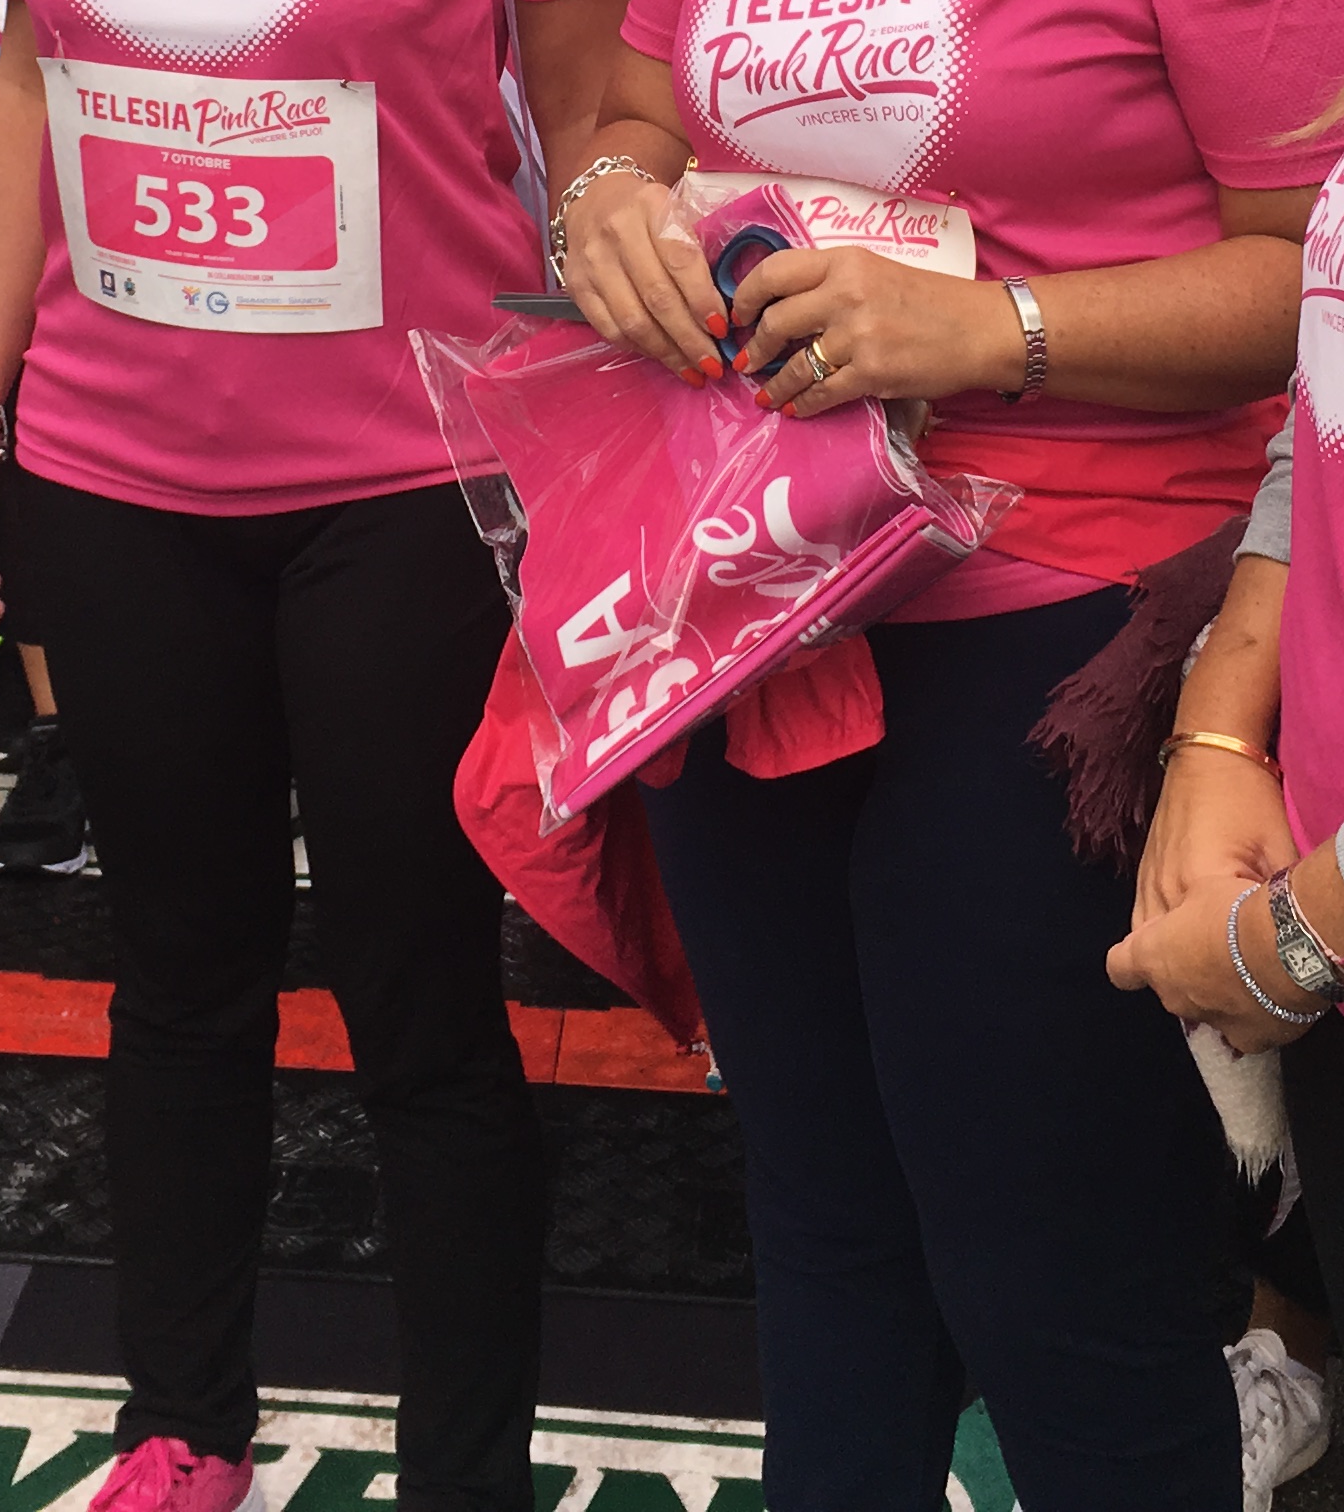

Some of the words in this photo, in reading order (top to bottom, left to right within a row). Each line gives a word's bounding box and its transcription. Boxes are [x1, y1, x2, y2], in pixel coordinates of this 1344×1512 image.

[880, 20, 931, 35] EDIZIONE
[703, 29, 813, 129] Pink
[813, 19, 936, 101] Race
[77, 88, 192, 133] TELESIA
[192, 97, 258, 144] Pink
[258, 90, 327, 130] Race
[796, 108, 861, 127] VINCERE
[863, 106, 878, 122] SI
[883, 100, 924, 122] PUÒ!
[248, 131, 288, 145] VINCERE
[288, 130, 298, 140] SI
[160, 151, 169, 163] 7
[169, 152, 232, 171] OTTOBRE
[134, 174, 269, 249] 533
[807, 195, 879, 236] Pink
[875, 197, 939, 245] Race
[895, 247, 905, 256] SI
